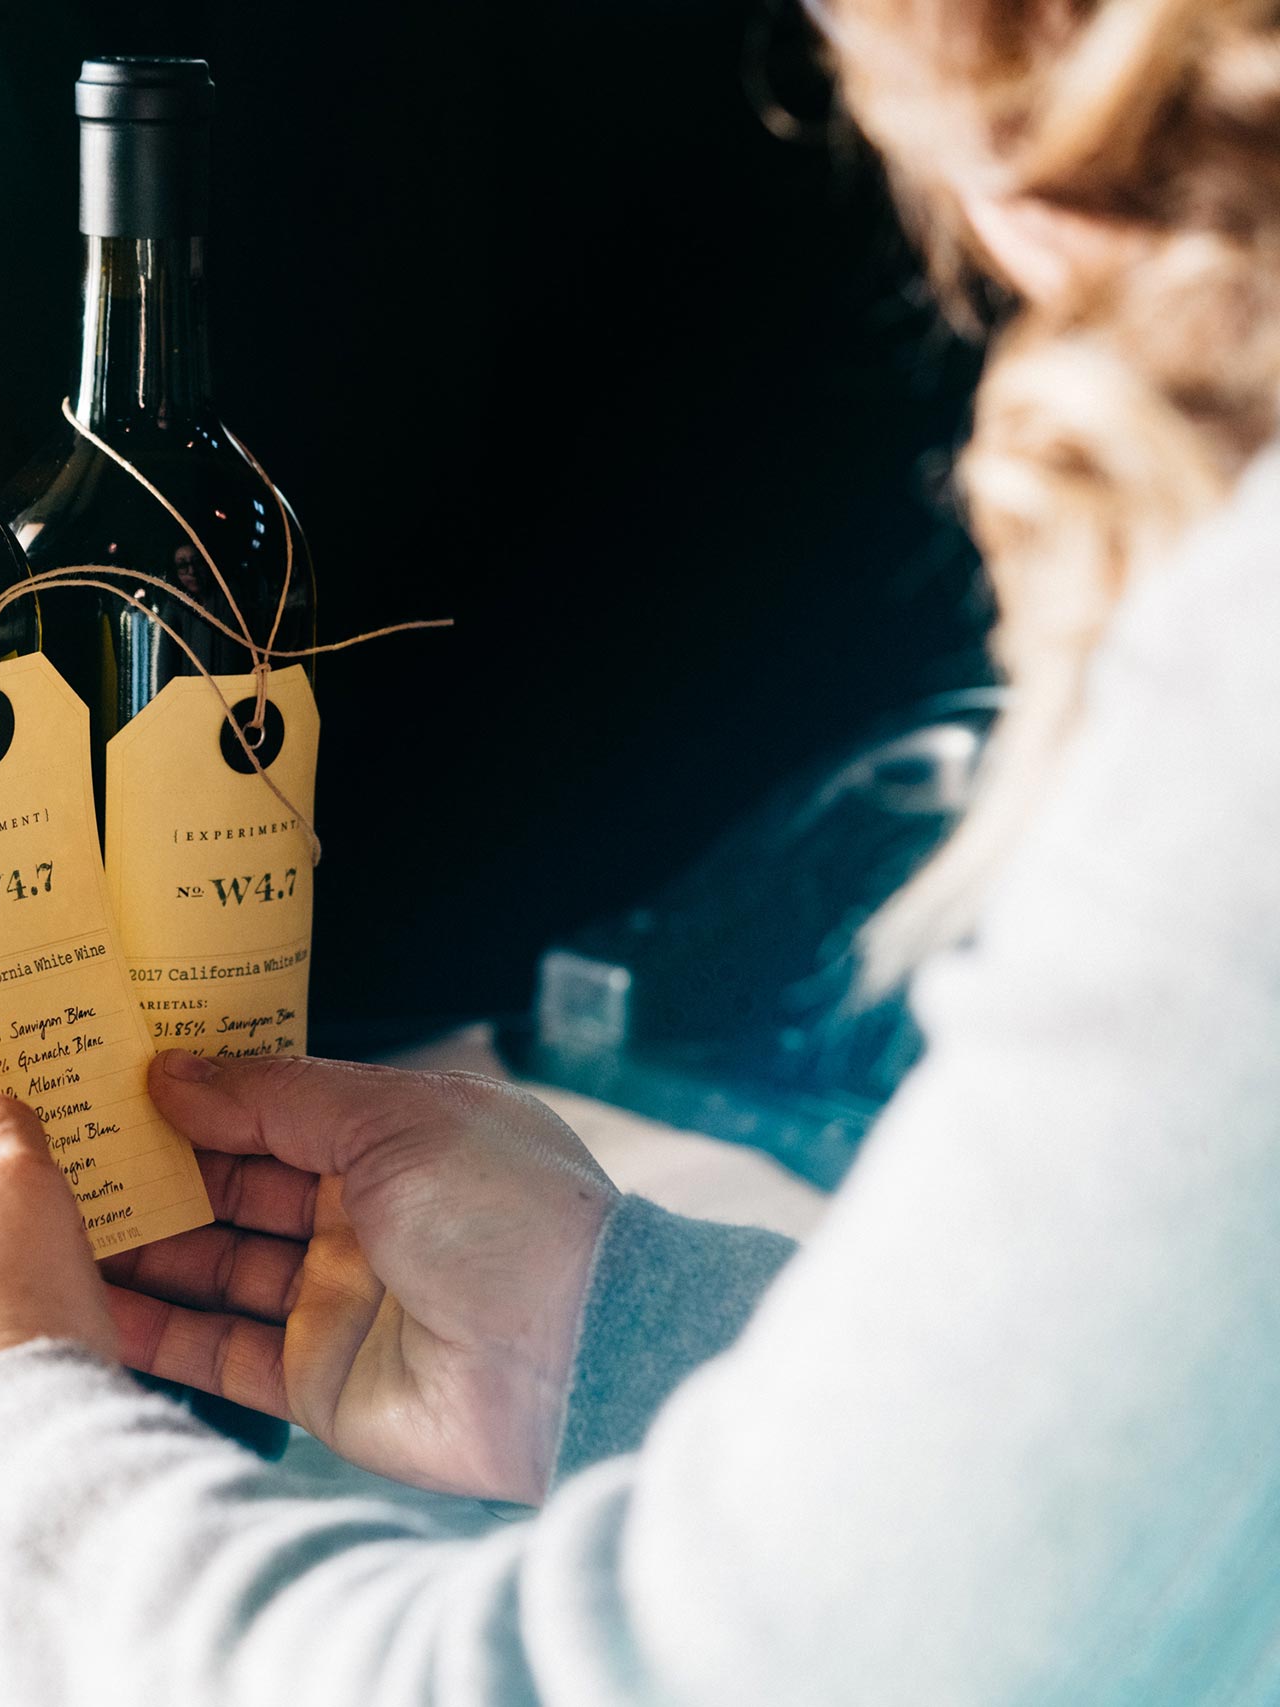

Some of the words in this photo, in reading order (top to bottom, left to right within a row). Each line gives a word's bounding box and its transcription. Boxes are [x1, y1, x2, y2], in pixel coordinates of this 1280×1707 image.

[208, 866, 297, 907] W4.7
[33, 952, 74, 973] White
[73, 943, 107, 962] Wine
[129, 969, 163, 981] 2017
[168, 962, 260, 981] California
[263, 955, 294, 973] White
[139, 1000, 208, 1010] ARIETALS:
[9, 1015, 62, 1040] Sauvignon
[63, 1006, 97, 1025] Blanc
[154, 1021, 206, 1037] 31.85%
[216, 1016, 273, 1037] Sauvignon
[17, 1044, 71, 1073] Grenache
[71, 1034, 104, 1054] Blanc
[28, 1067, 81, 1097] Albariño
[35, 1100, 92, 1123] Roussanne
[84, 1122, 121, 1140] Blanc
[73, 1180, 124, 1202] rmentino
